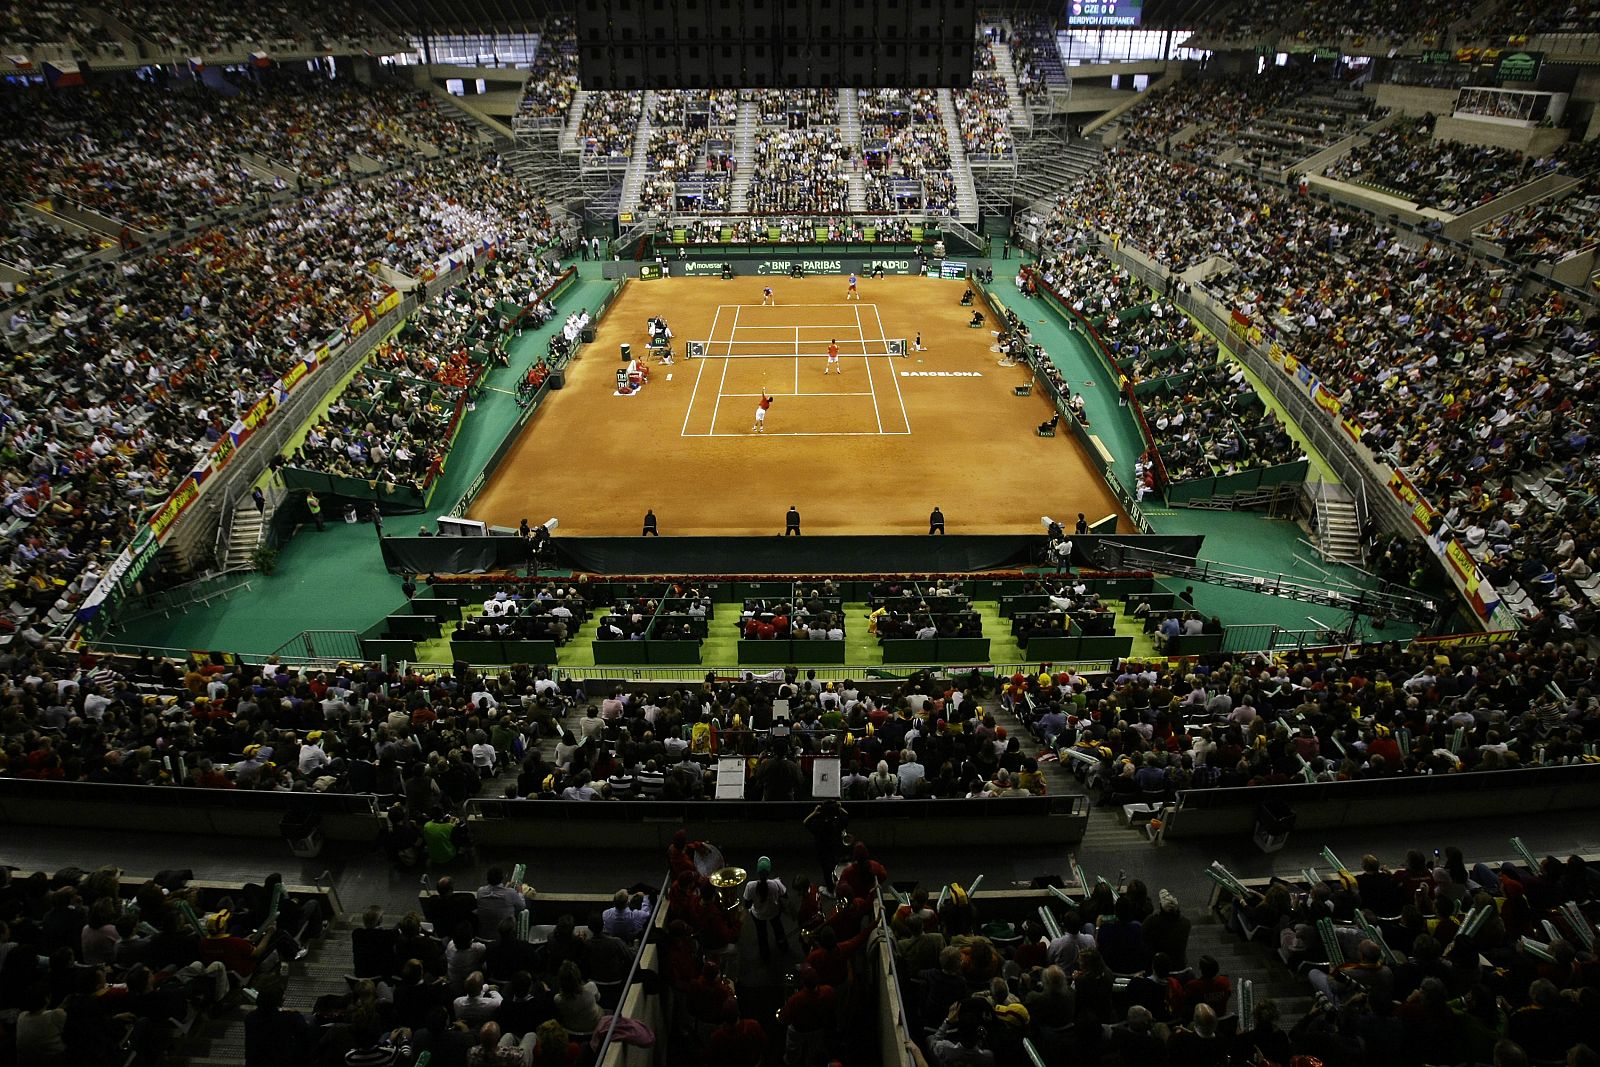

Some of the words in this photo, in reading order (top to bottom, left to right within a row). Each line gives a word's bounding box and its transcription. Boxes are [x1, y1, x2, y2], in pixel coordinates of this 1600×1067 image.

[1084, 4, 1099, 14] CZE
[1101, 4, 1107, 14] 0
[1109, 4, 1115, 14] 0
[1102, 16, 1135, 25] STEPANEK
[771, 261, 791, 270] BNP
[803, 260, 841, 270] PARIBAS
[128, 540, 160, 582] MAPFRE
